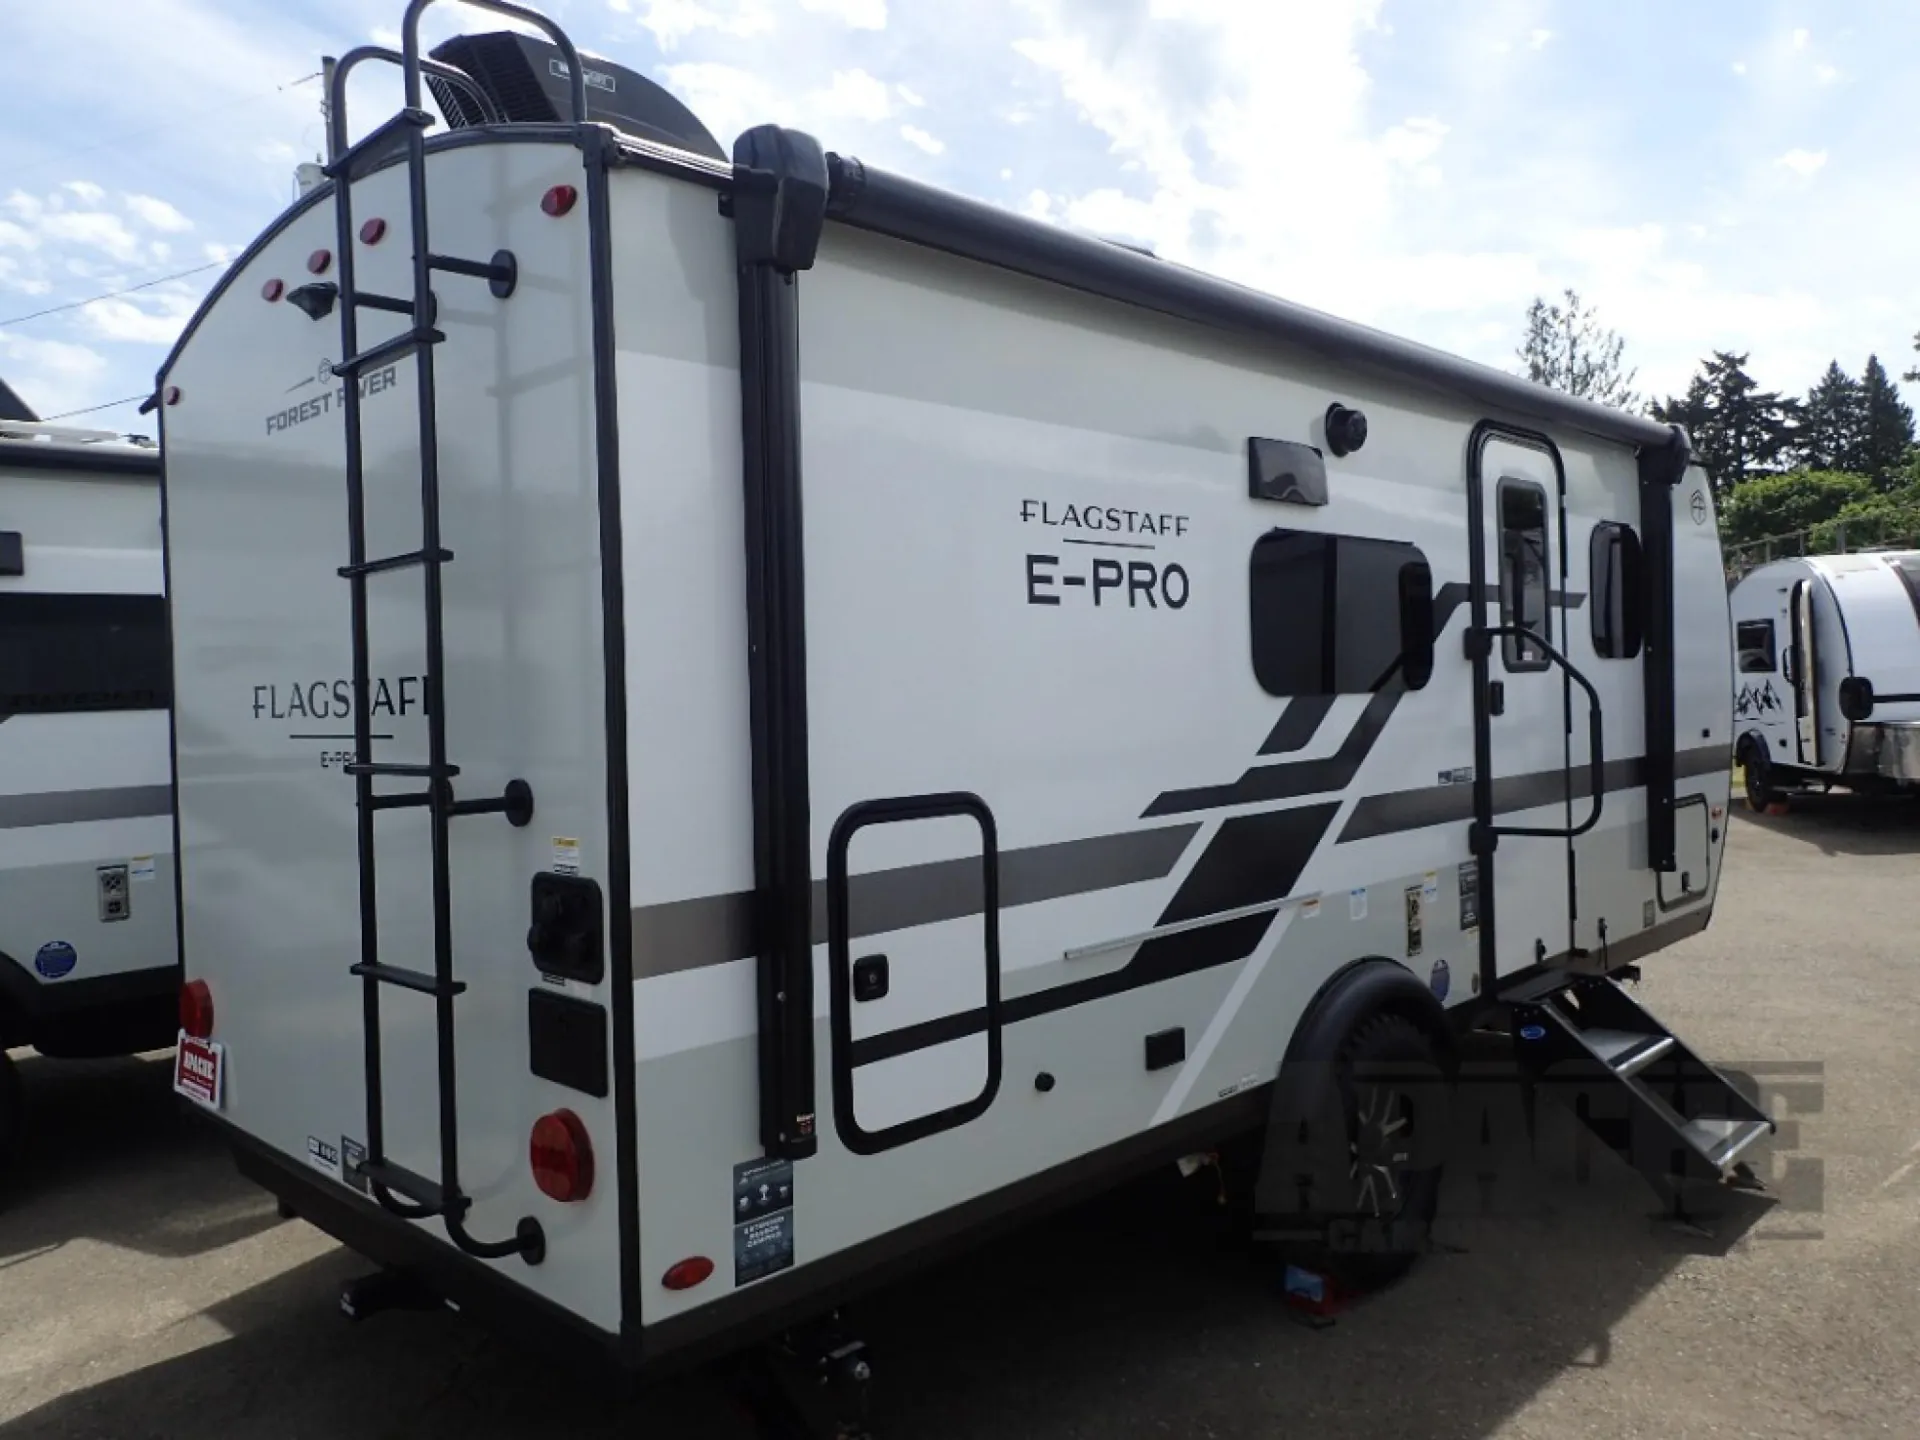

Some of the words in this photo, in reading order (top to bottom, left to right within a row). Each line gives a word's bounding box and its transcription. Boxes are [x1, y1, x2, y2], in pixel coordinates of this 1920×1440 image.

[265, 391, 333, 436] FOREST
[336, 365, 397, 408] RVER
[1019, 499, 1190, 537] FLAGSTAFF
[1026, 553, 1190, 610] E-PRO
[252, 675, 429, 720] FLAGSAF
